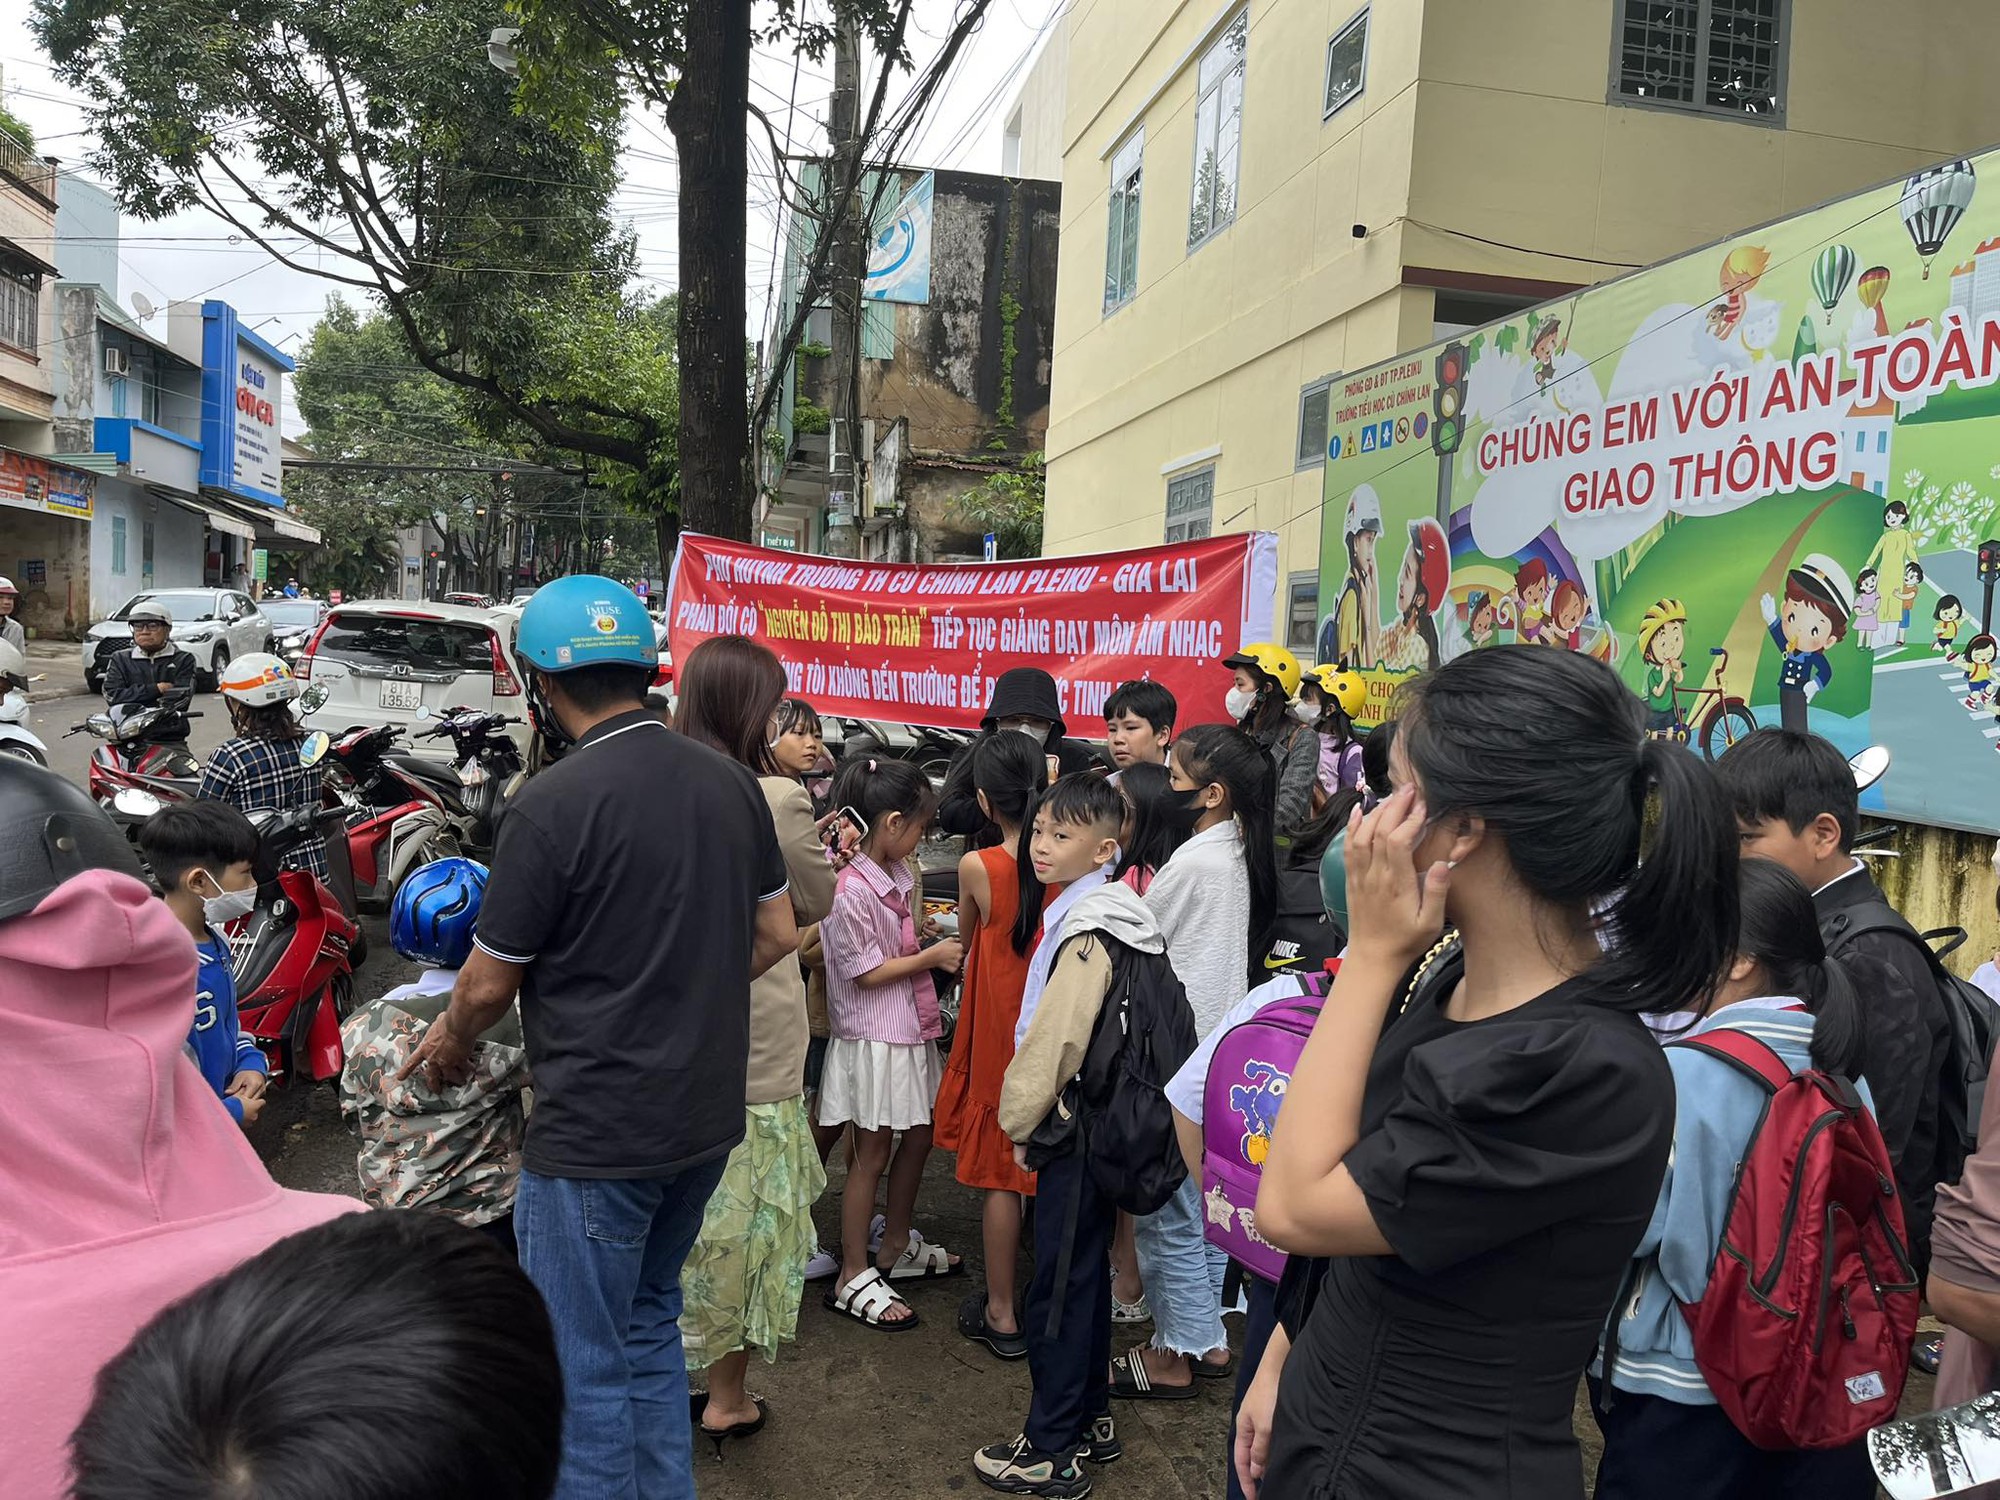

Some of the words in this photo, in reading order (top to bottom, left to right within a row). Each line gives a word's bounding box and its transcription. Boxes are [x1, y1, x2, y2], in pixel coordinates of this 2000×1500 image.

[1373, 397, 1385, 415] HỌC
[1396, 386, 1416, 406] CHÍNH
[1417, 383, 1431, 400] LAN
[1480, 413, 1591, 470] CHÚNG
[1603, 397, 1658, 448] EM
[1672, 370, 1749, 433] VỚI
[1760, 356, 1834, 418] AN
[1564, 462, 1654, 513] GIAO
[1669, 431, 1836, 500] THÔNG
[704, 554, 732, 588] PHỤ
[734, 557, 793, 585] HUYNH
[788, 561, 864, 591] TRƯỜNG
[861, 570, 892, 593] TH
[887, 565, 920, 594] CÙ
[917, 566, 982, 595] CHÍNH
[977, 570, 1025, 595] LAN
[1020, 565, 1100, 594] PLEIKU
[1112, 562, 1153, 593] GIA
[1159, 557, 1198, 593] LAI
[675, 593, 716, 634] PHẢN
[717, 595, 739, 635] ĐỐI
[811, 600, 828, 642] ĐỖ
[830, 611, 851, 650] THỊ
[854, 602, 881, 646] BẢO
[931, 605, 964, 650] TIẾP
[967, 616, 997, 658] TỤC
[1000, 606, 1050, 655] GIẢNG
[1054, 619, 1088, 663] DẠY
[1093, 613, 1136, 656] MÔN
[1133, 613, 1167, 656] ÂM
[1168, 619, 1222, 666] NHẠC
[381, 694, 420, 708] 135.52
[390, 682, 412, 695] 81A
[806, 657, 826, 695] TÔI
[828, 660, 870, 700] KHÔNG
[871, 659, 899, 703] ĐẾN
[900, 665, 957, 708] TRƯỜNG
[960, 662, 982, 709] ĐỂ
[1271, 939, 1301, 959] NIKE
